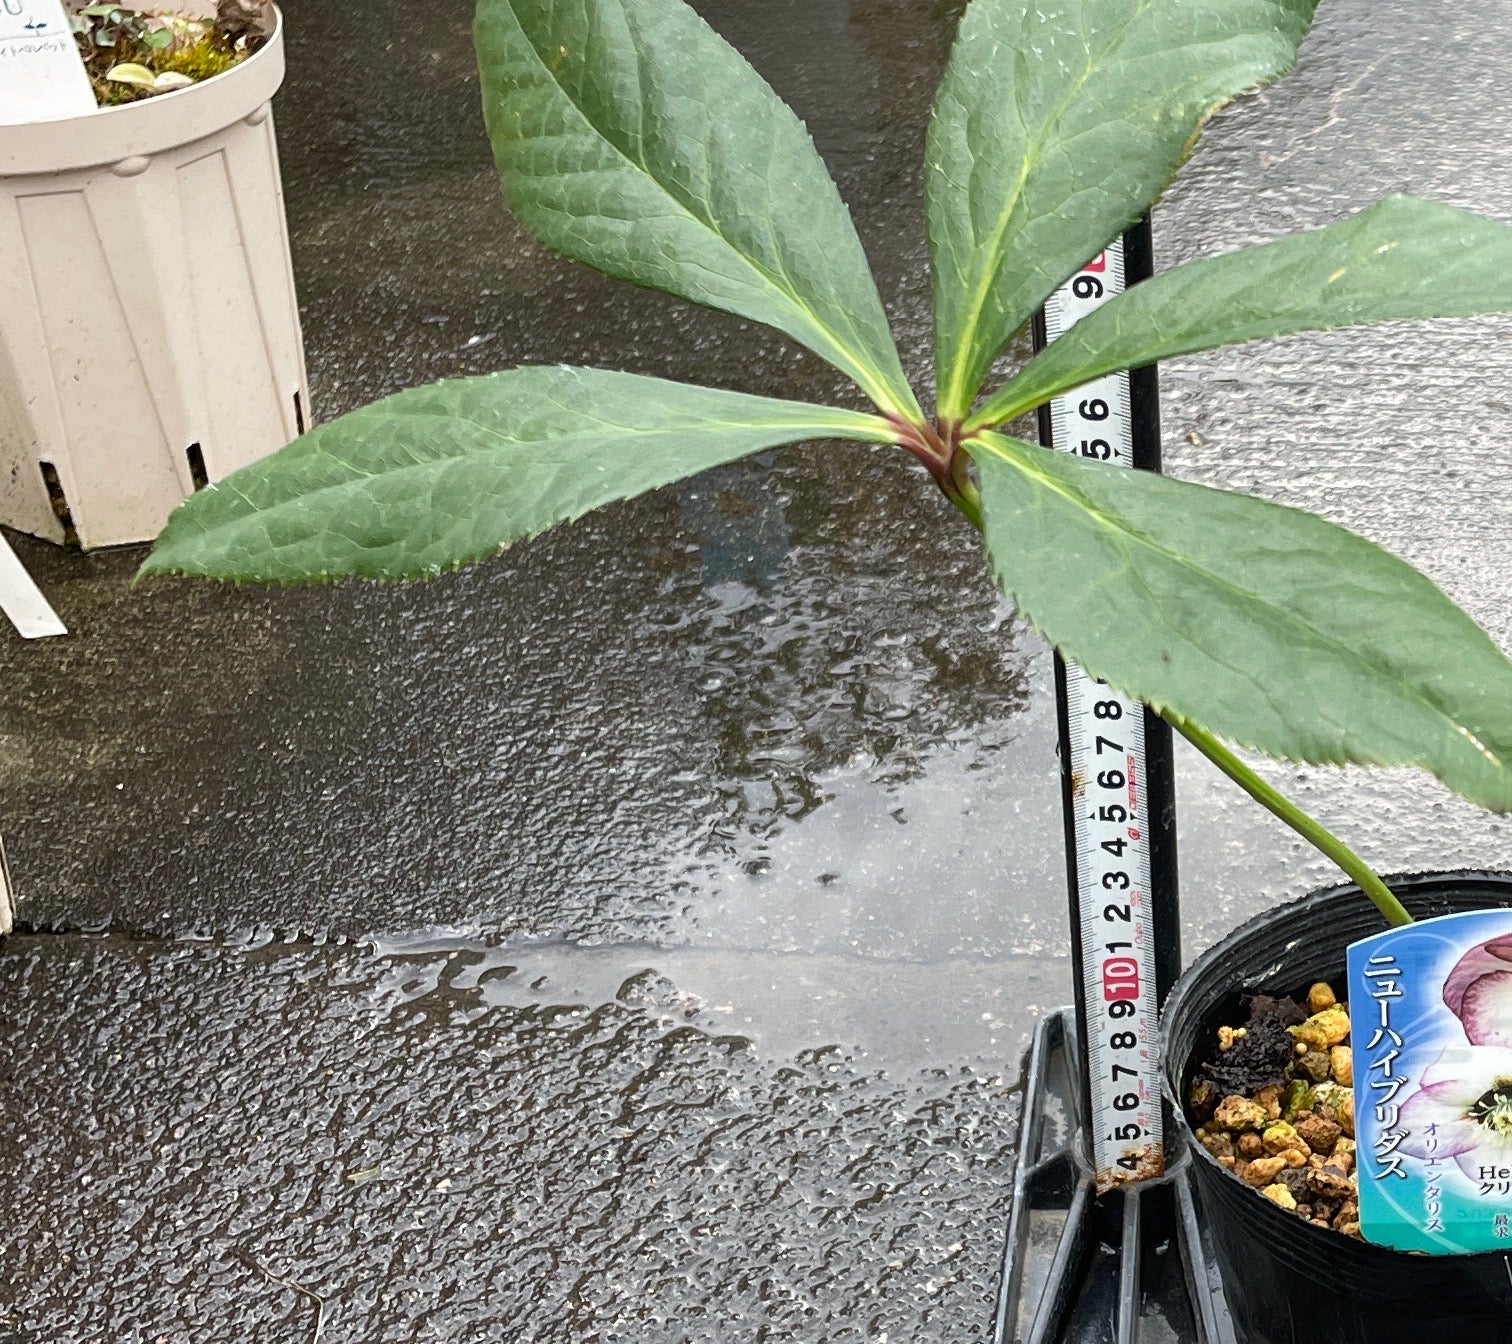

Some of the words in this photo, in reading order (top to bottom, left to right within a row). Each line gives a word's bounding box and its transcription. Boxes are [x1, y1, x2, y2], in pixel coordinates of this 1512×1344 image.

[1072, 275, 1104, 299] 9
[1079, 399, 1110, 421] 6
[1081, 439, 1111, 461] 5
[1093, 700, 1122, 721] 8
[1096, 735, 1123, 755] 7
[1097, 770, 1126, 789] 6
[1099, 804, 1127, 823] 5
[1101, 837, 1128, 857] 4
[1102, 870, 1130, 890] 3
[1103, 904, 1131, 923] 2
[1106, 942, 1132, 954] 1
[1105, 962, 1136, 991] 10
[1108, 999, 1135, 1019] 9
[1110, 1031, 1137, 1050] 8
[1112, 1064, 1138, 1083] 7
[1364, 956, 1408, 1179] ニューハイブリダス
[1113, 1091, 1140, 1112] 6
[1115, 1123, 1141, 1141] 5
[1117, 1153, 1142, 1171] 4
[1423, 1122, 1444, 1231] オリエンタリス
